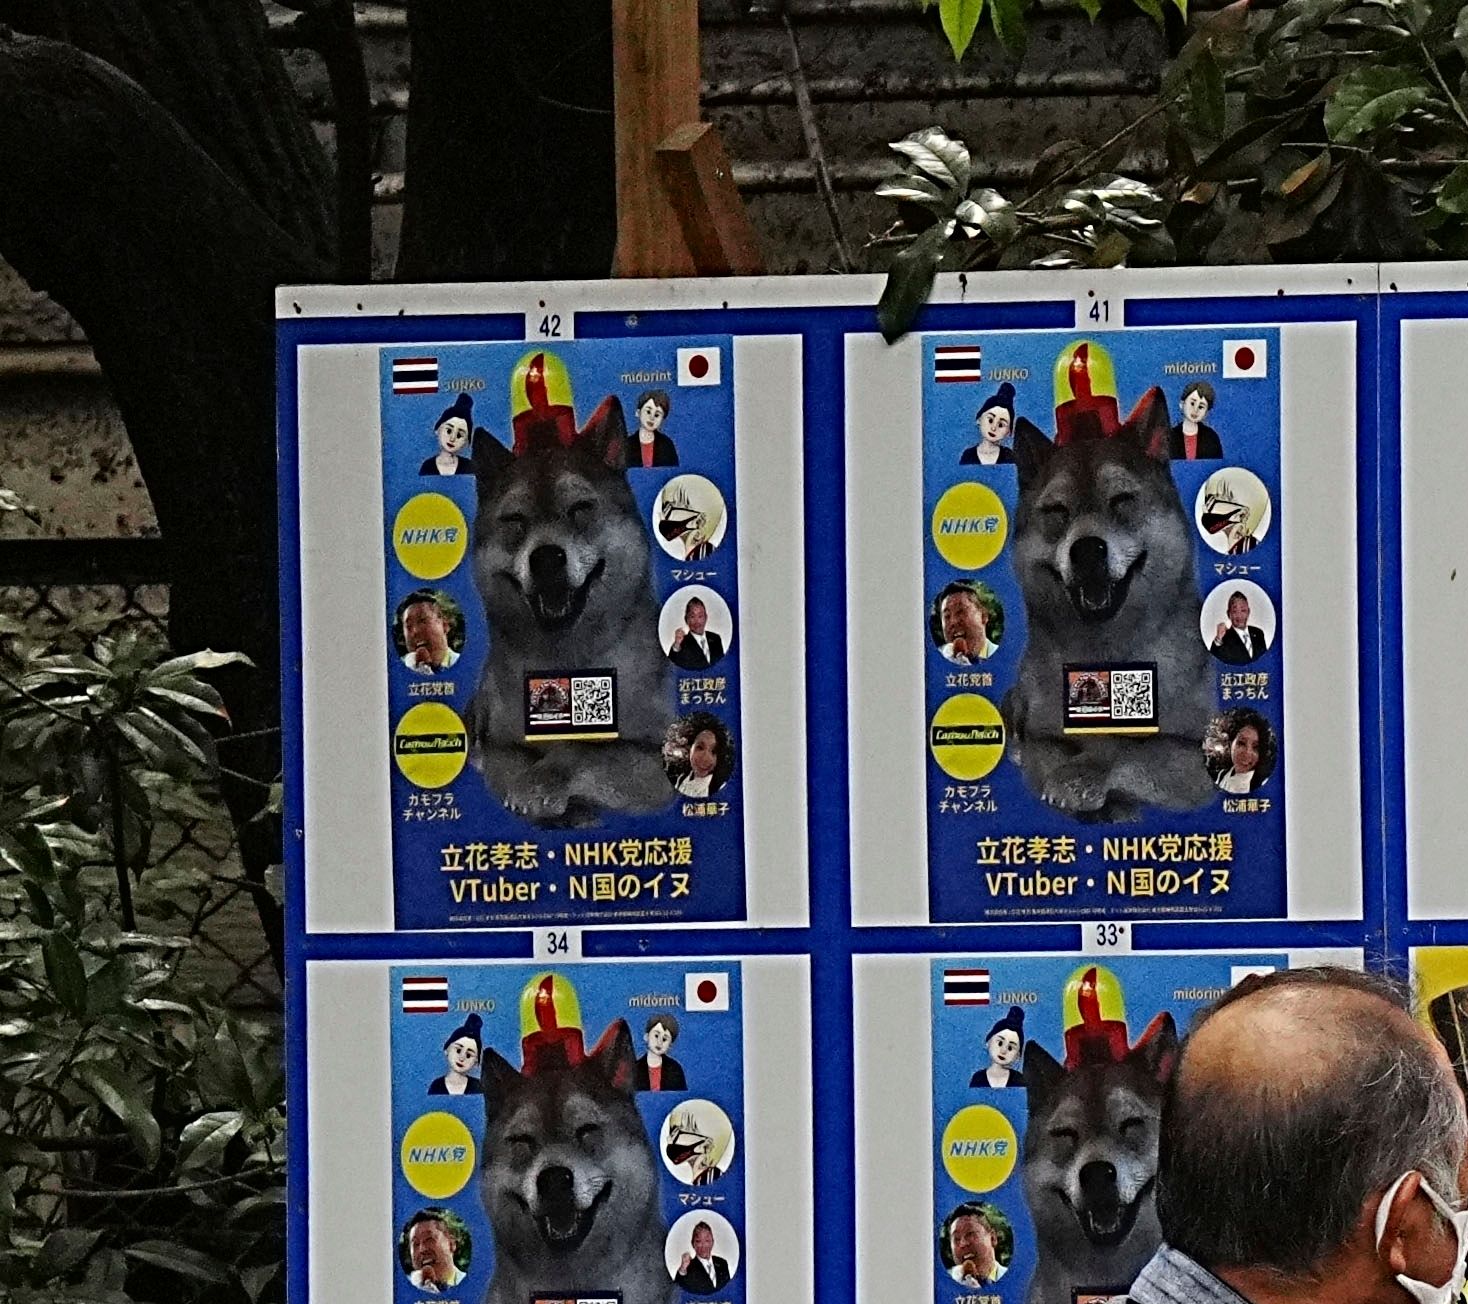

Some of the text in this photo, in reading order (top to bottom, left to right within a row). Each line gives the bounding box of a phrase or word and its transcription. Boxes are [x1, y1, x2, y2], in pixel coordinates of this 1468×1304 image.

[540, 315, 561, 337] 42
[440, 830, 693, 879] 立花孝志・NHK党応援
[547, 931, 568, 954] 34
